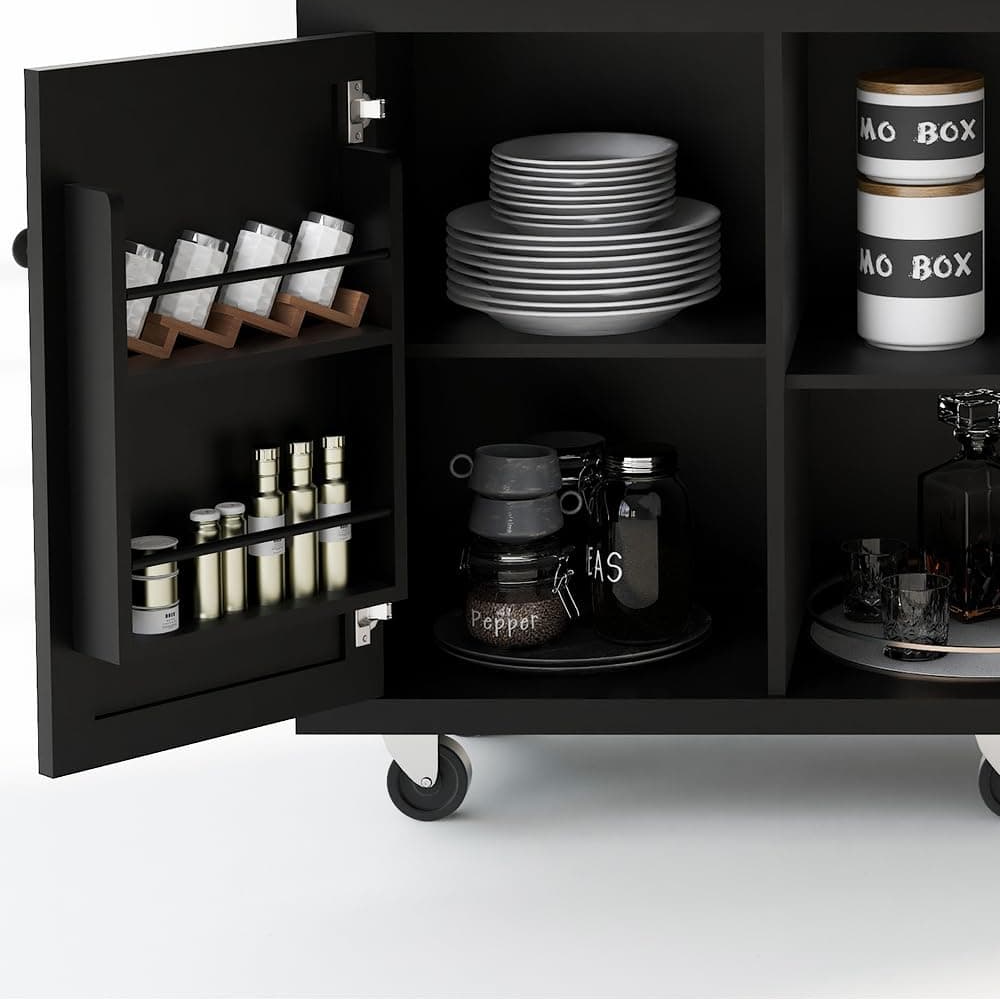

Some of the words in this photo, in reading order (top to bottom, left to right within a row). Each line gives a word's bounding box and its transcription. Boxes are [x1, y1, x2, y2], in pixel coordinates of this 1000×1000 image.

[860, 117, 896, 142] MO
[914, 118, 976, 145] BOX
[860, 248, 893, 278] MO
[910, 252, 972, 281] BOX
[586, 545, 623, 583] EAS
[470, 608, 538, 637] Pepper
